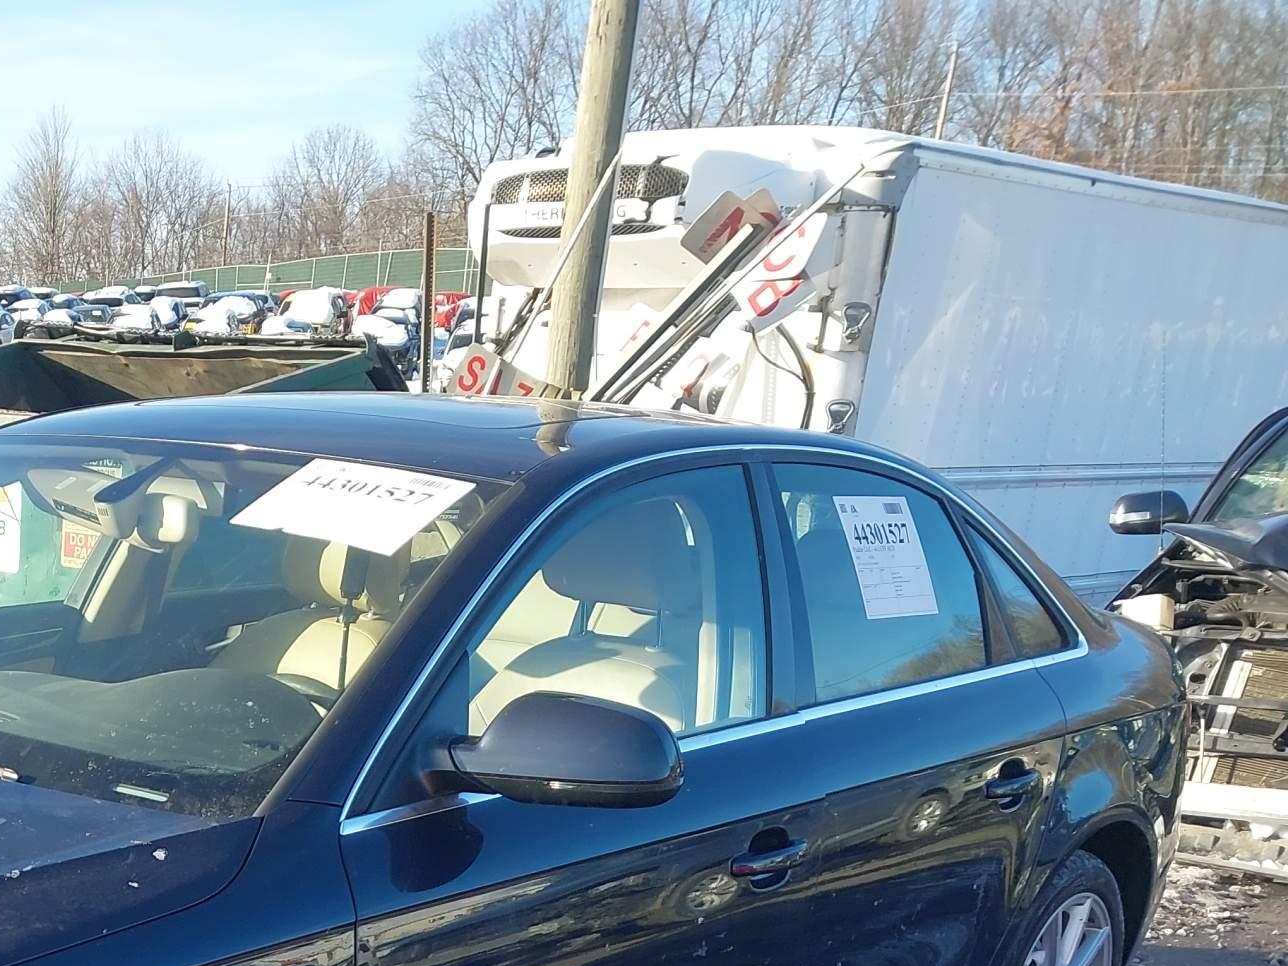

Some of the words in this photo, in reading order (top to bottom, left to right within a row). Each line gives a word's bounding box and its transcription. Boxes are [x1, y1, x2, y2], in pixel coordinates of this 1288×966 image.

[458, 355, 486, 392] S
[302, 475, 435, 505] 44301527
[69, 533, 85, 546] DO
[853, 522, 910, 545] 44301527
